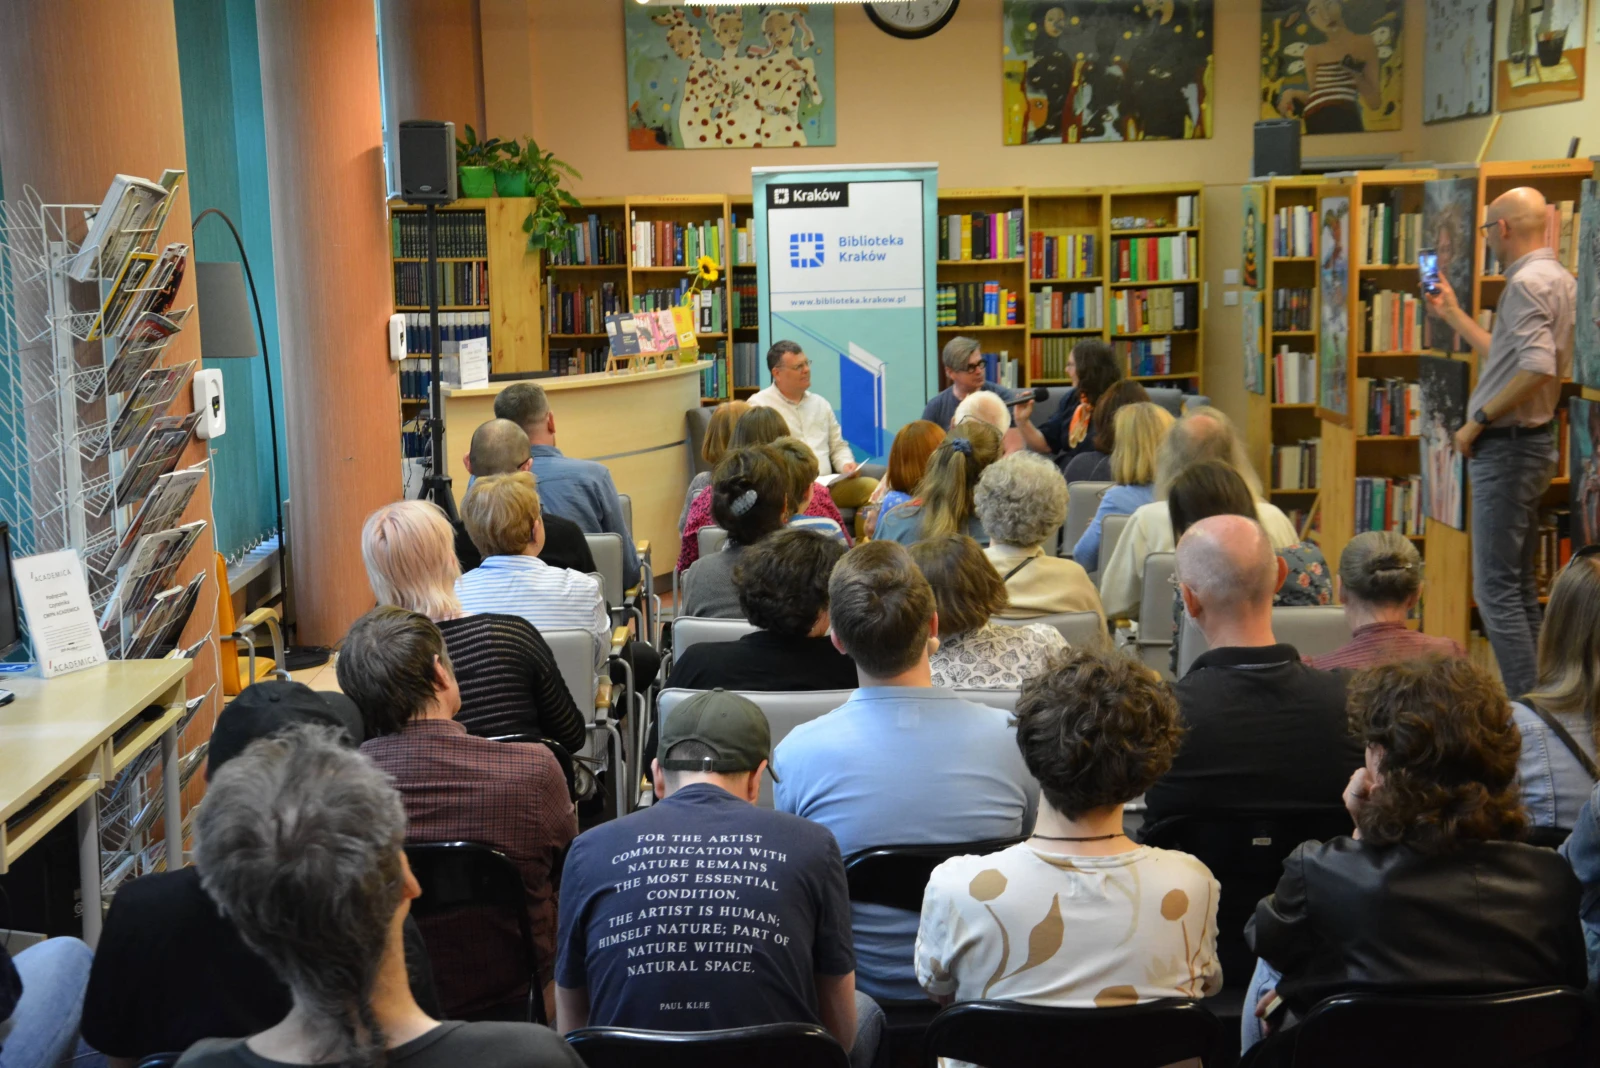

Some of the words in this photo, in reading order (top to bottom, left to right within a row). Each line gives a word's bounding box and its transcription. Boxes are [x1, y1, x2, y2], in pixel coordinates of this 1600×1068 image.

[793, 188, 841, 202] Kraków
[839, 234, 904, 247] Biblioteka
[839, 251, 887, 262] Kraków
[791, 295, 906, 306] www.biblioteka.krakow.pl
[34, 569, 71, 582] ACADEMICA
[53, 657, 98, 673] ACADEMICA
[637, 834, 665, 843] FOR
[672, 834, 702, 842] THE
[709, 834, 762, 843] ARTIST
[612, 846, 743, 865] COMMUNICATION
[750, 847, 787, 863] WITH
[628, 859, 689, 874] NATURE
[696, 860, 767, 872] REMAINS
[614, 878, 641, 893] THE
[647, 873, 689, 885] MOST
[695, 874, 779, 891] ESSENTIAL
[647, 890, 740, 900] CONDITION.
[609, 912, 633, 928] THE
[638, 906, 693, 919] ARTIST
[699, 906, 713, 916] IS
[720, 907, 781, 927] HUMAN;
[598, 926, 652, 949] HIMSELF
[657, 924, 727, 936] NATURE;
[733, 925, 769, 939] PART
[774, 933, 789, 946] OF
[627, 942, 687, 958] NATURE
[694, 942, 753, 954] WITHIN
[627, 961, 698, 977] NATURAL
[704, 961, 755, 974] SPACE.
[660, 1002, 682, 1010] PAUL
